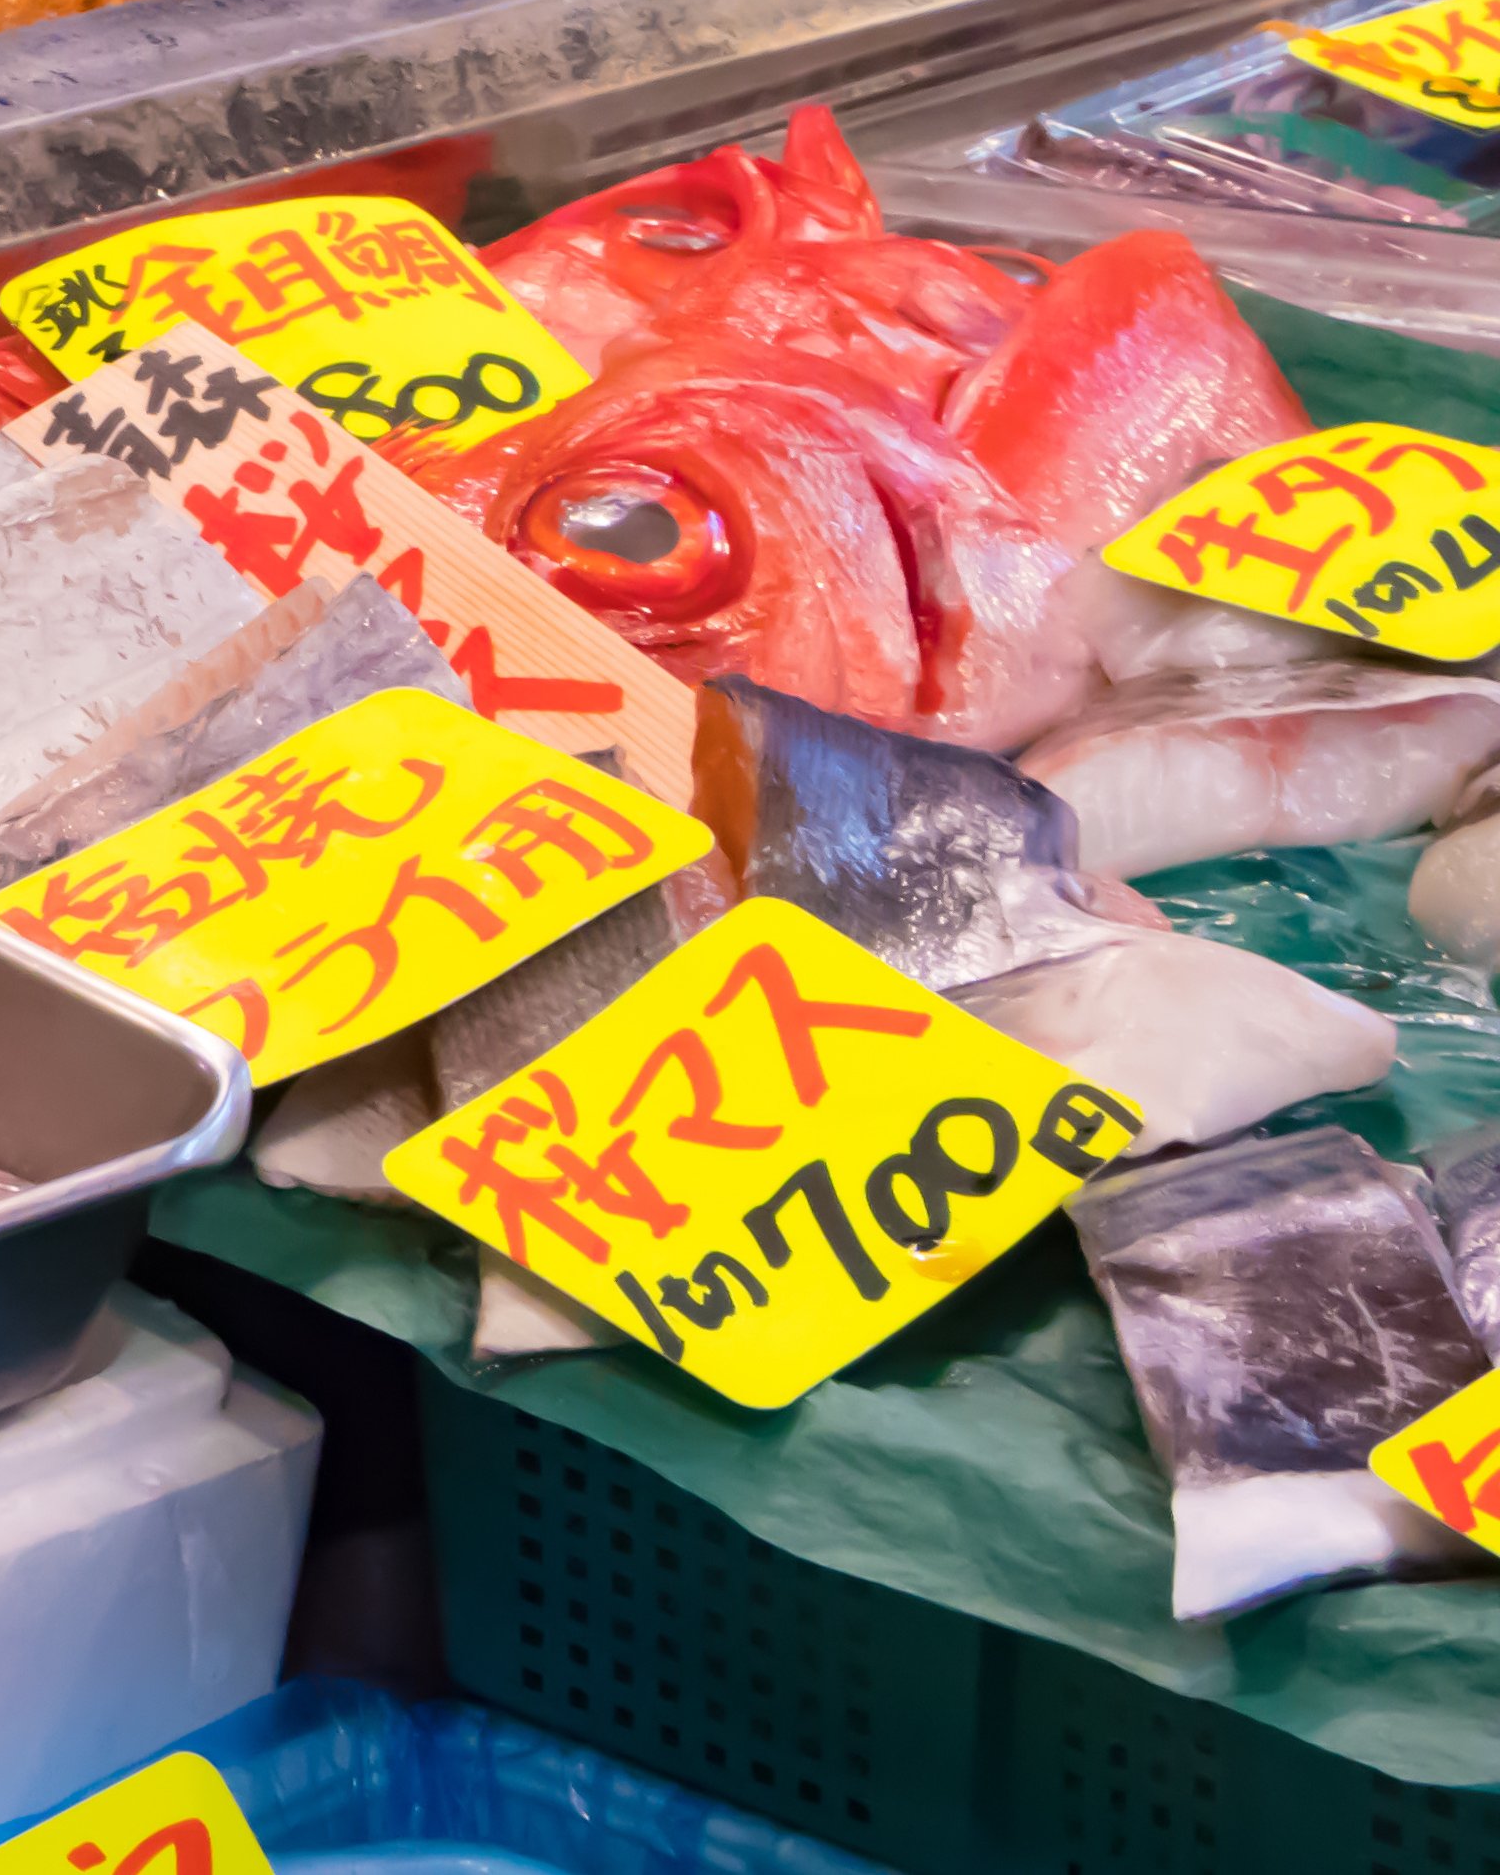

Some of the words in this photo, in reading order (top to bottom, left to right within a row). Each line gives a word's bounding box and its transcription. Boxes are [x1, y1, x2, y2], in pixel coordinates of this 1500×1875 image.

[106, 211, 508, 346] 金目鯛
[1156, 436, 1489, 614] 生タラ
[180, 776, 655, 1061] フライ用
[440, 942, 934, 1268] 桜マス
